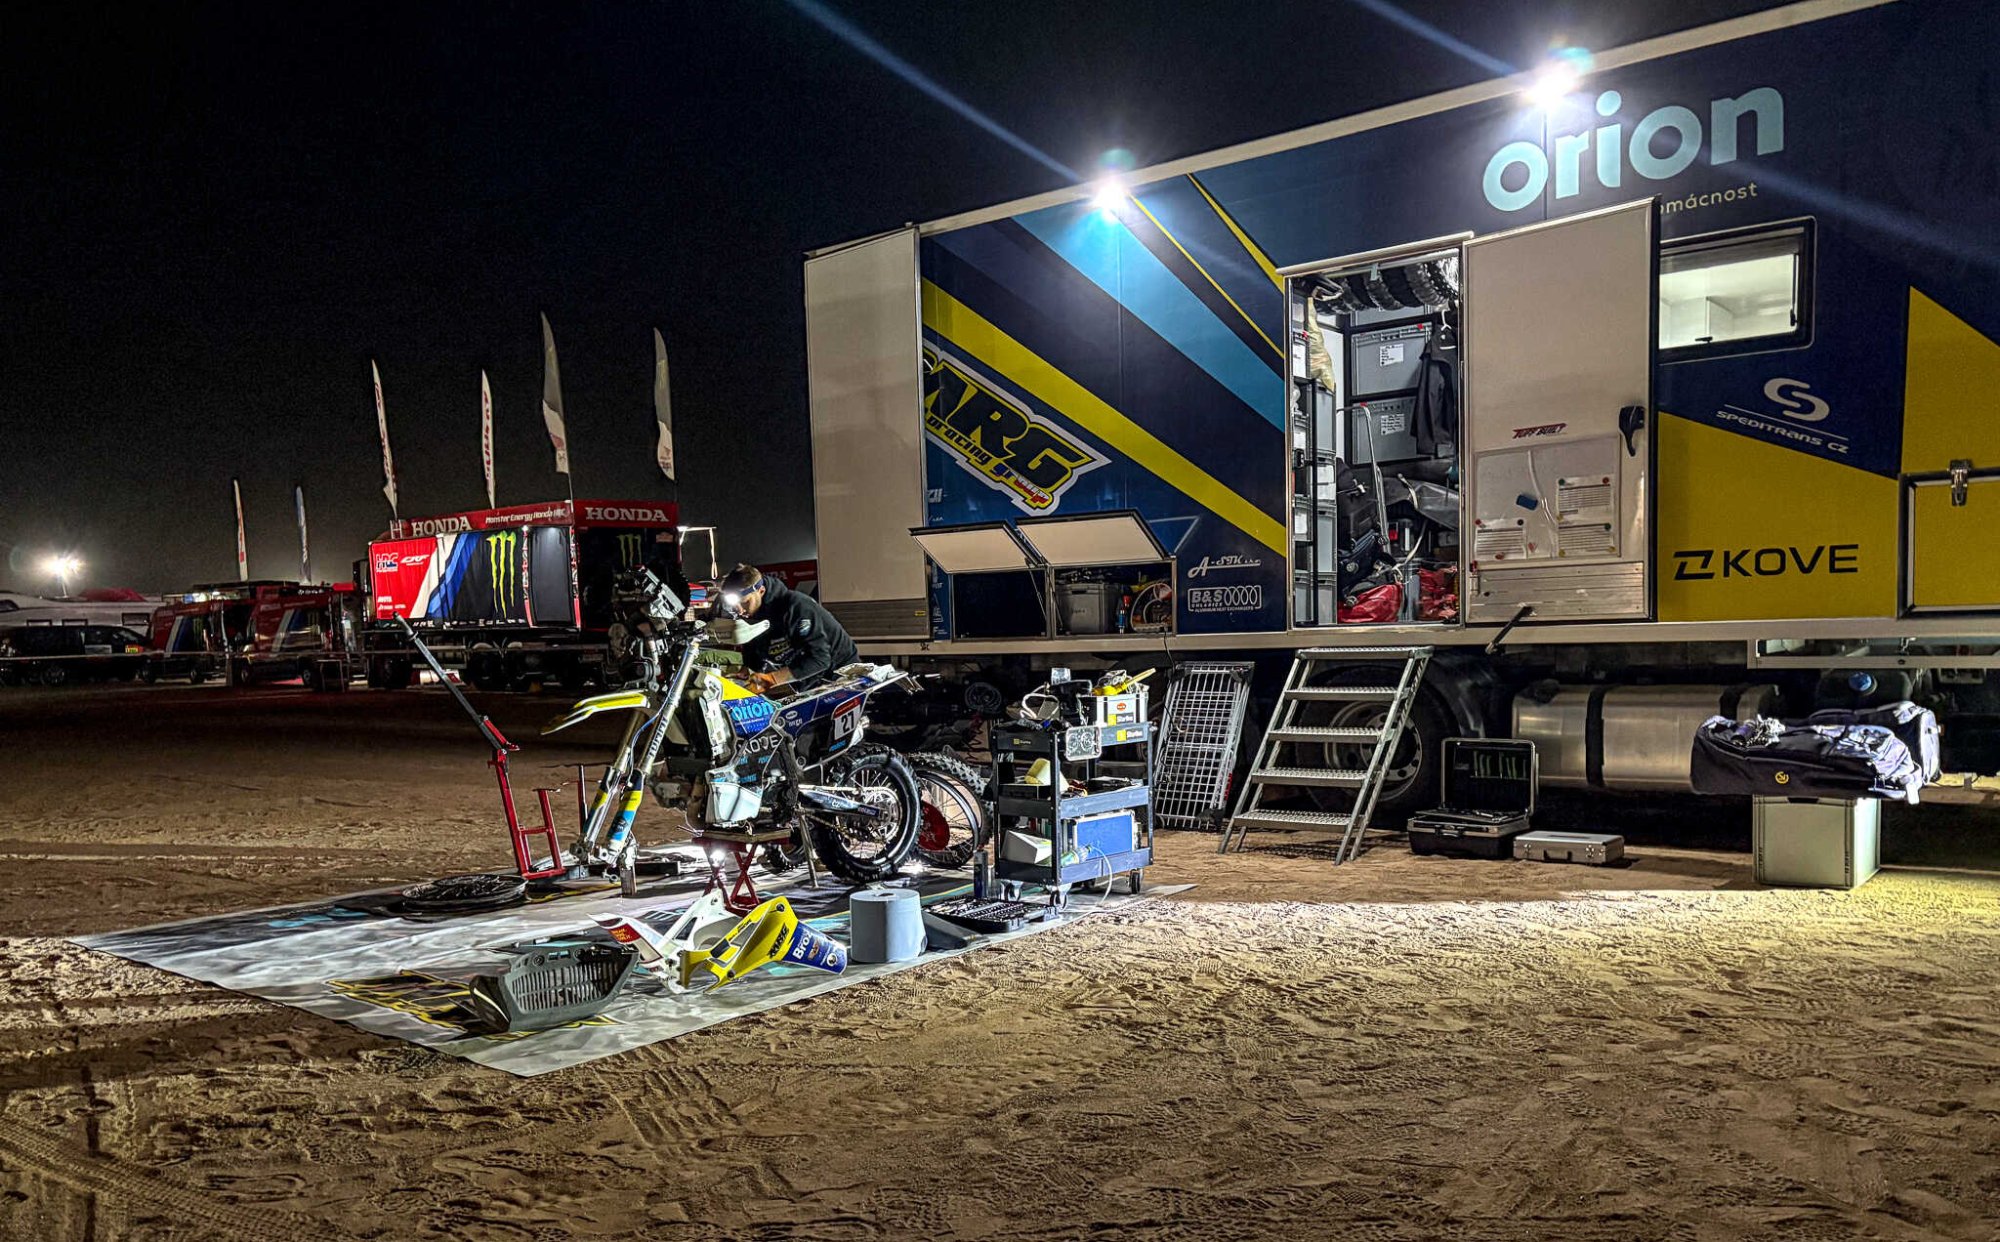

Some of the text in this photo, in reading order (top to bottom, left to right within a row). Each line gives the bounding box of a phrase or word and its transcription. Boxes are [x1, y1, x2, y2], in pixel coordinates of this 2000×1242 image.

[1482, 87, 1784, 212] orion
[1827, 442, 1850, 454] CZ
[585, 506, 670, 522] HONDA
[411, 515, 473, 537] HONDA
[1722, 544, 1859, 578] KOVE
[1191, 589, 1223, 603] B&S
[731, 700, 774, 721] orion
[841, 711, 856, 733] 27
